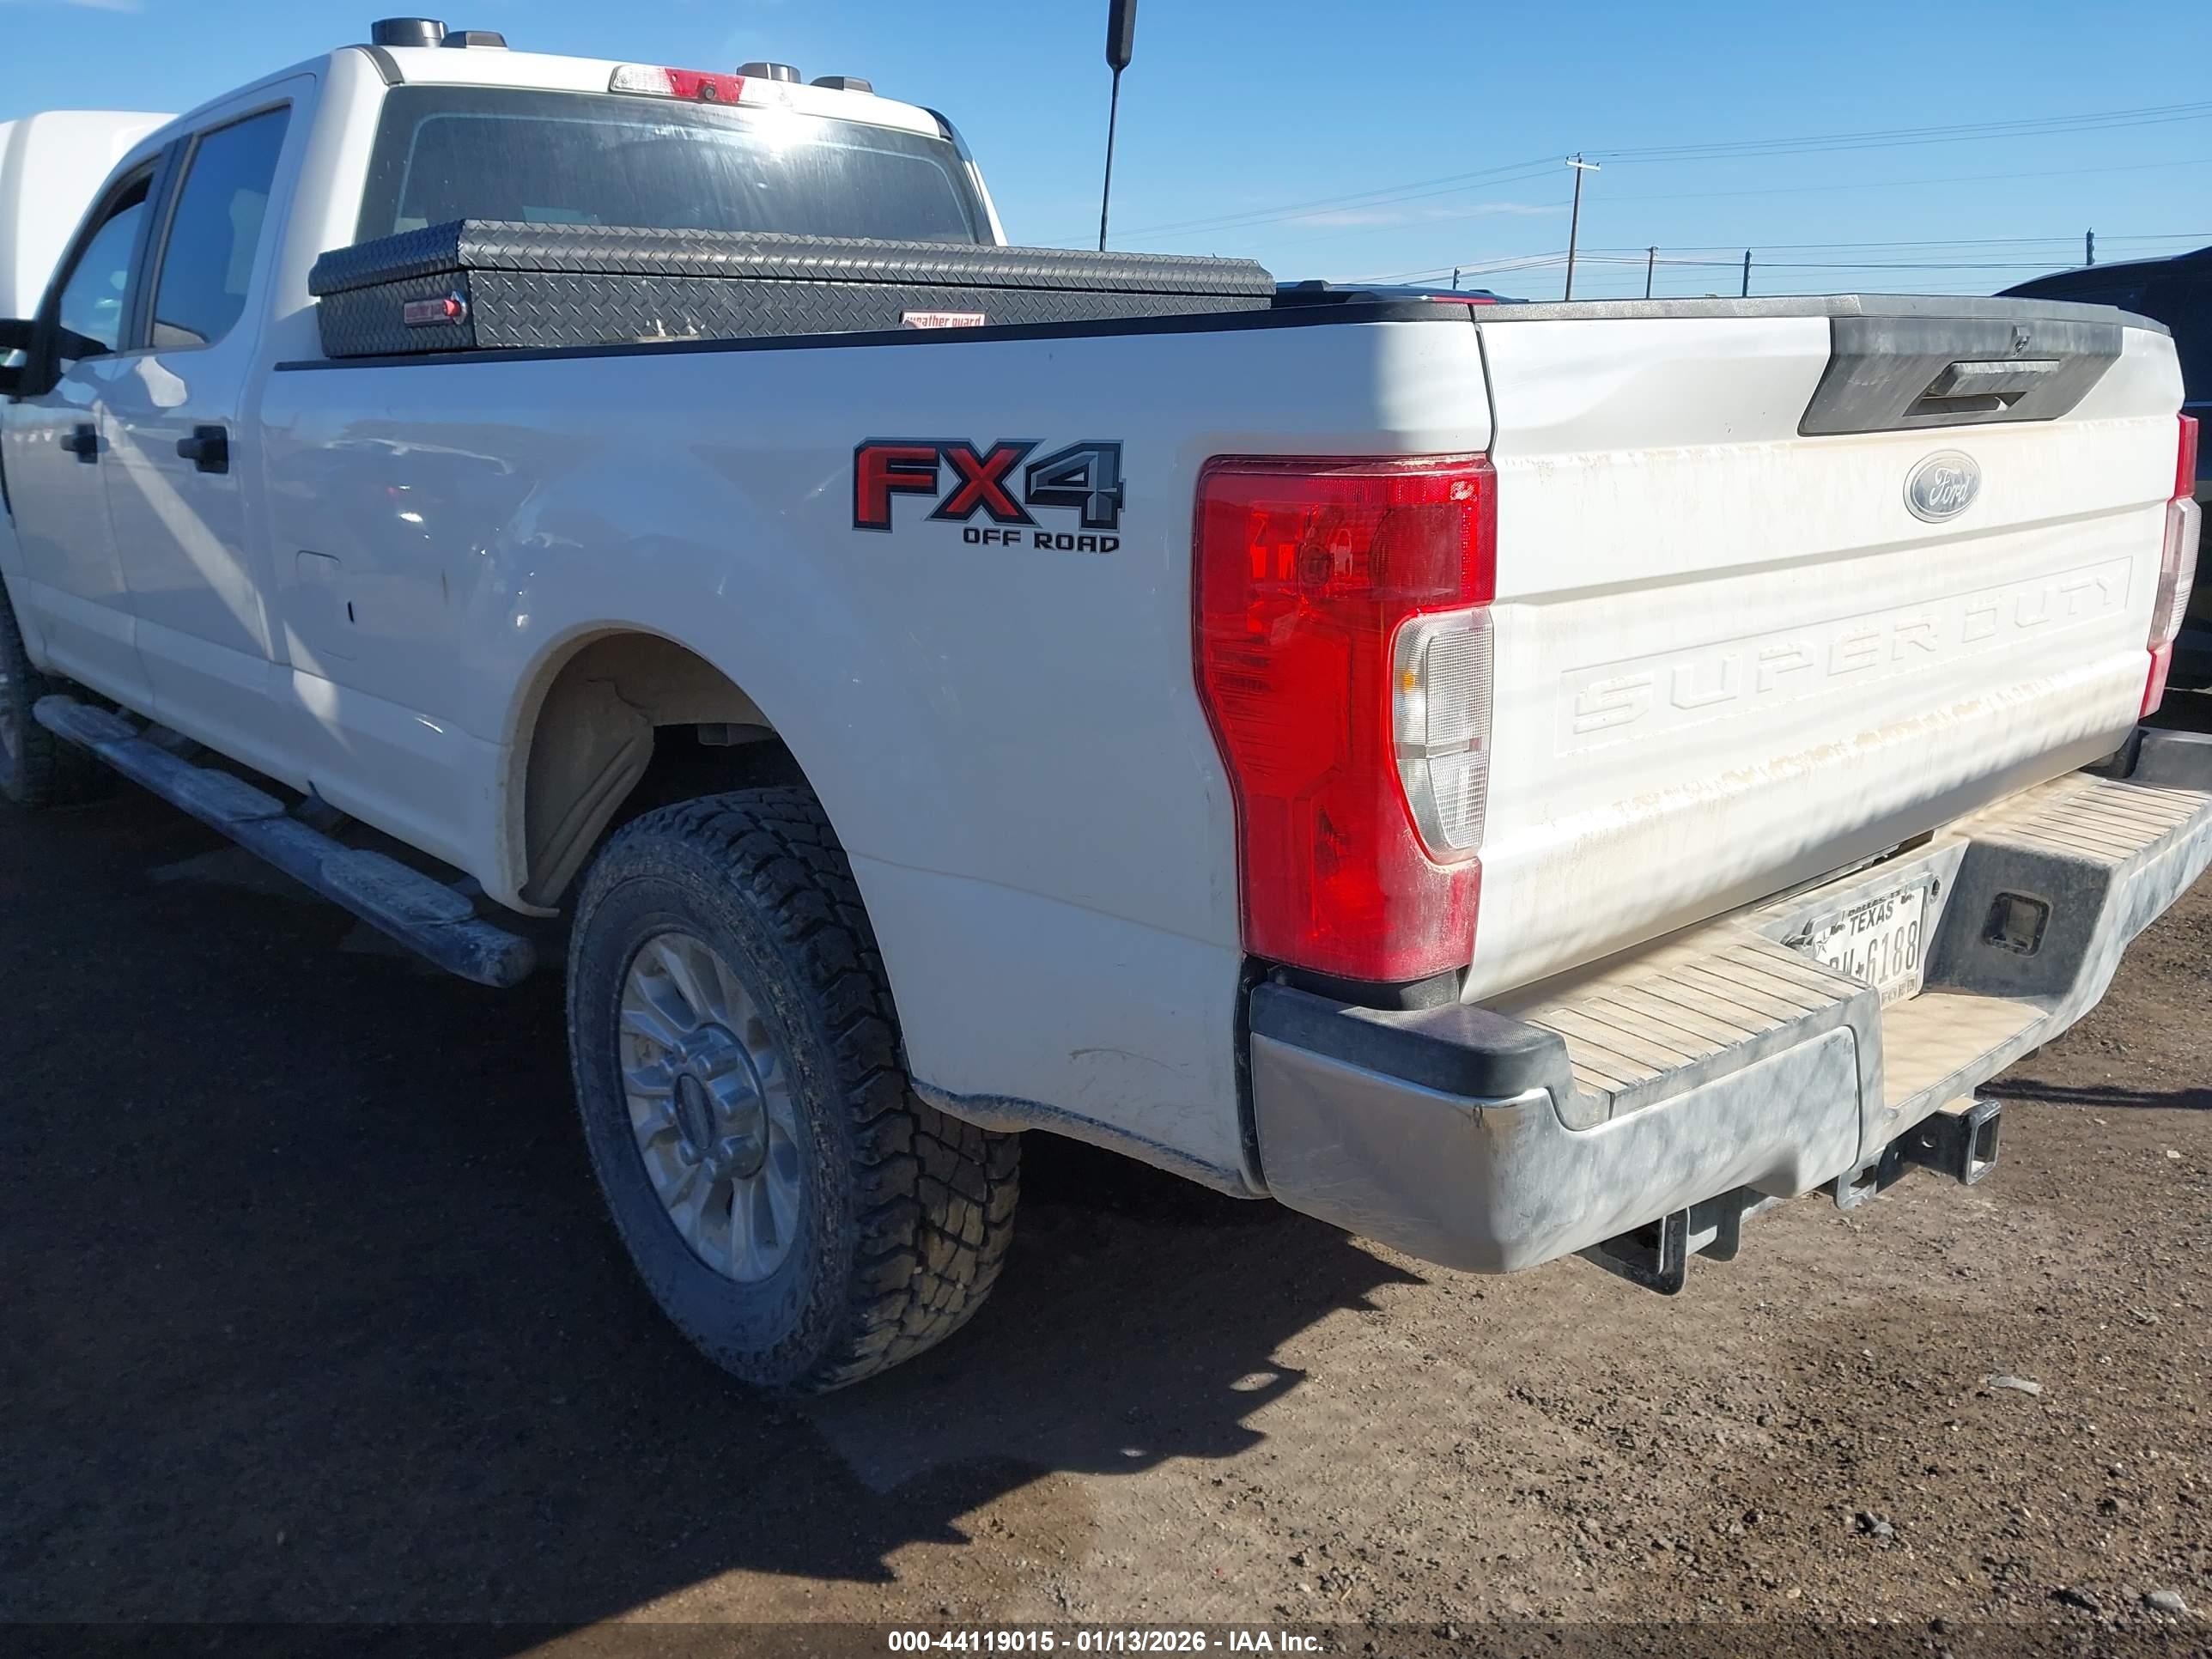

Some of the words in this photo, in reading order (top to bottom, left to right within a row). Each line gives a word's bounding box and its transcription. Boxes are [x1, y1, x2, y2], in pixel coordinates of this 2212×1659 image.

[852, 437, 1126, 534] FX4
[1929, 466, 1971, 507] Ford
[963, 526, 1021, 547] OFF
[1033, 531, 1120, 553] ROAD
[1573, 613, 1939, 736] SUPER
[1960, 567, 2126, 644] DUTY
[1850, 899, 1894, 937] TEXAS
[1866, 920, 1918, 986] 6188
